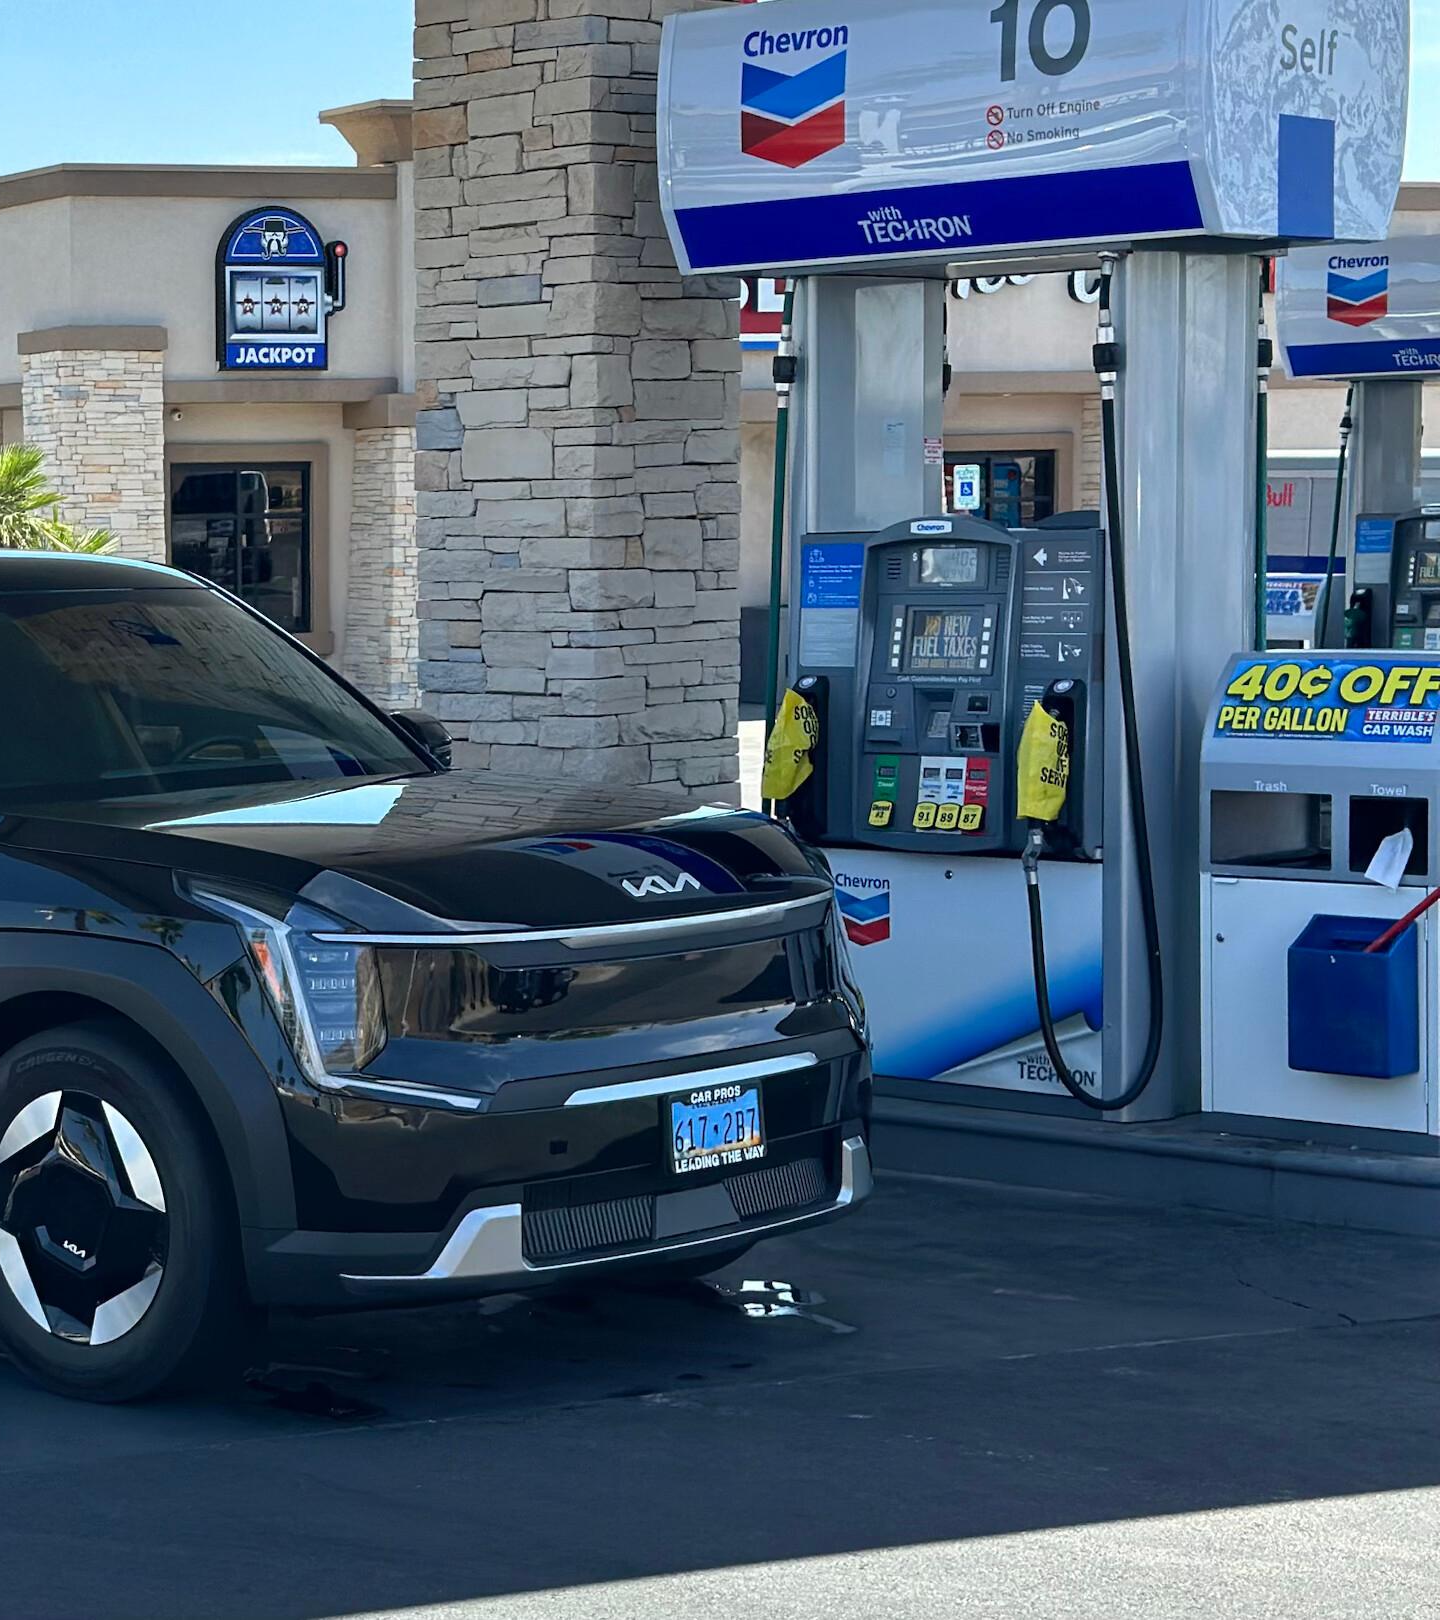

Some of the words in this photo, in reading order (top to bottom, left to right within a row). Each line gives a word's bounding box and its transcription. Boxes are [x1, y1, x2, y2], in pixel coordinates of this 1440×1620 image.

[744, 25, 848, 57] Chevron
[990, 0, 1091, 82] 10
[1280, 24, 1338, 75] Self
[1007, 107, 1033, 120] Turn
[1037, 102, 1055, 116] Off
[1059, 99, 1101, 115] Engine
[1007, 132, 1023, 143] No
[1027, 126, 1080, 142] Smoking
[867, 206, 902, 221] with
[857, 215, 972, 244] TECHRON
[1328, 255, 1389, 270] Chevron
[236, 347, 315, 364] JACKPOT
[1392, 353, 1440, 367] TECHR
[916, 523, 946, 532] Chevron
[944, 615, 972, 636] NEW
[912, 636, 940, 657] FUEL
[943, 636, 978, 657] TAXES
[1226, 664, 1334, 702] 40¢
[1339, 665, 1440, 705] OFF
[1218, 705, 1261, 731] PER
[1263, 706, 1349, 733] GALLON
[1368, 710, 1436, 722] TERRIBLE'S
[1363, 723, 1390, 736] CAR
[1393, 725, 1434, 737] WASH
[1040, 767, 1066, 788] SERV
[1254, 780, 1288, 793] Trash
[1370, 783, 1407, 796] Towel
[918, 811, 931, 822] 91
[940, 812, 954, 823] 89
[963, 813, 977, 824] 87
[622, 872, 701, 897] KIA
[835, 873, 890, 890] Chevron
[1017, 1060, 1095, 1087] TECHON
[691, 1090, 713, 1104] CAR
[714, 1085, 741, 1101] PROS
[675, 1153, 720, 1174] LEADING
[721, 1149, 742, 1165] THE
[744, 1145, 765, 1160] WAY
